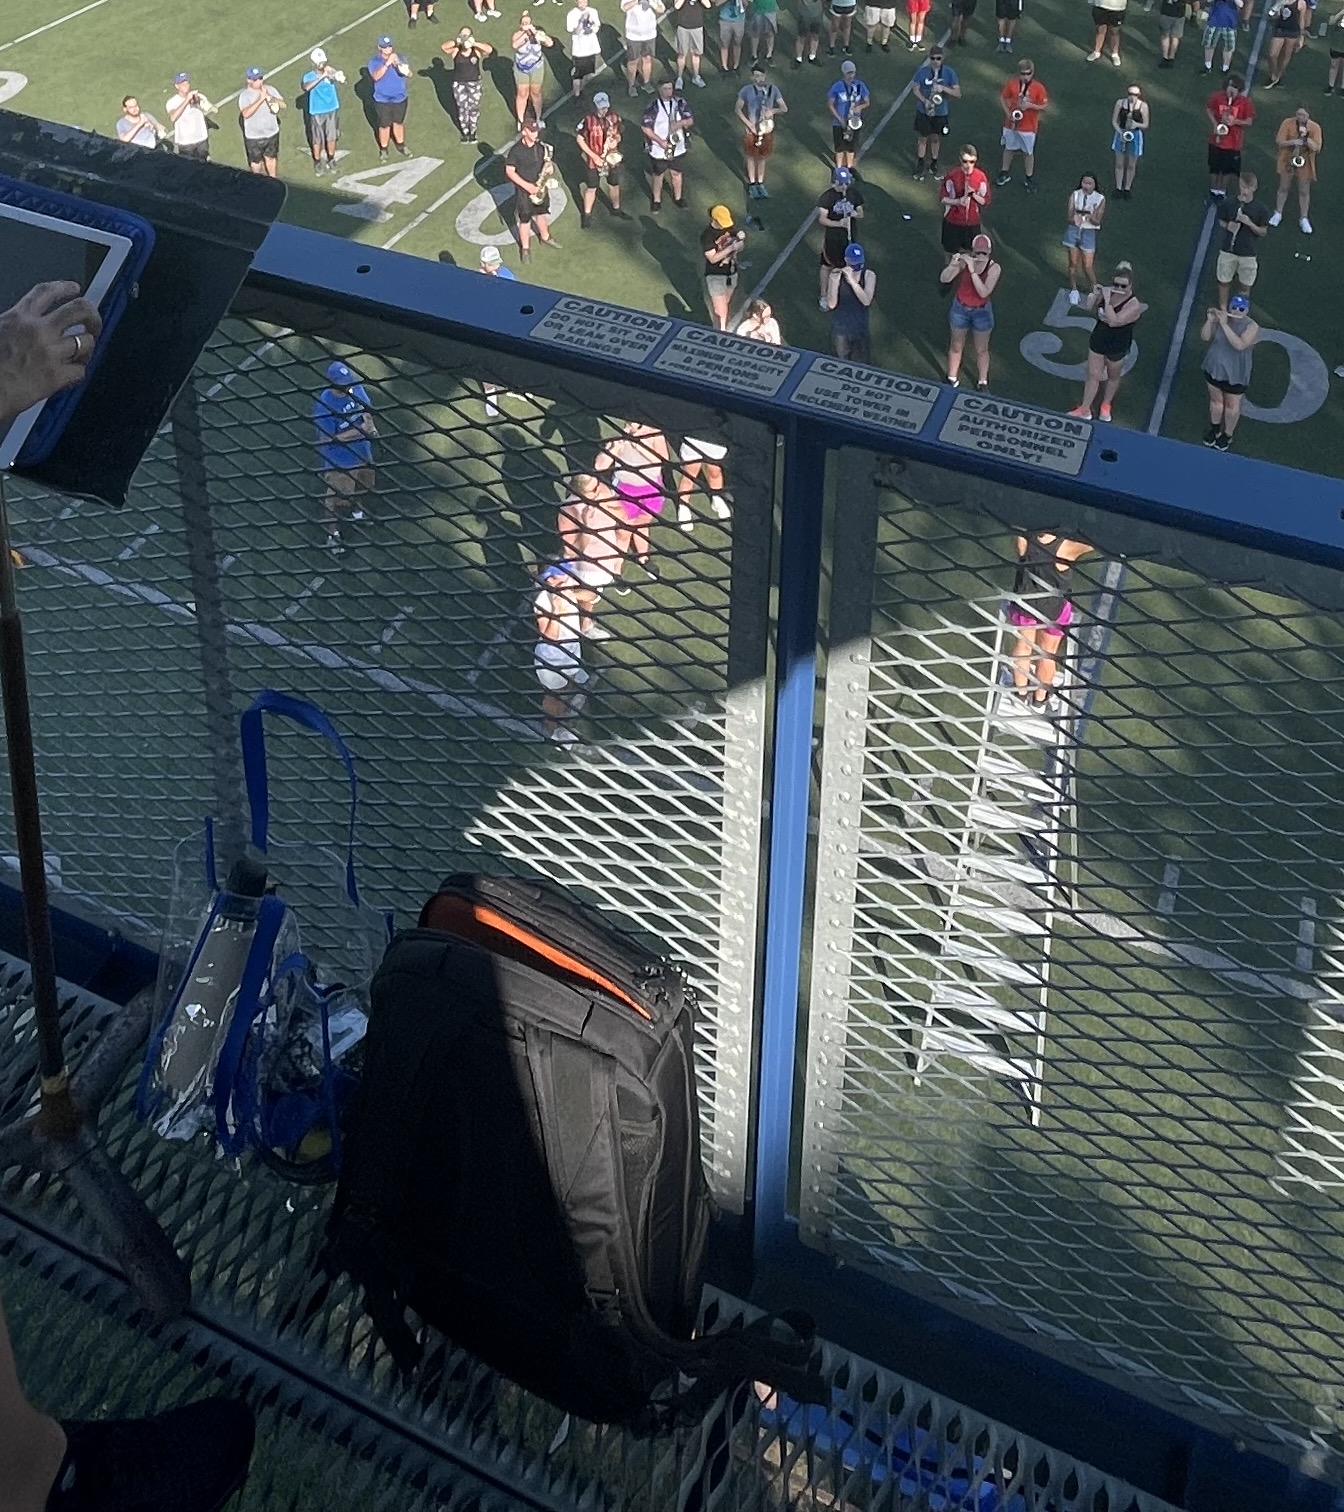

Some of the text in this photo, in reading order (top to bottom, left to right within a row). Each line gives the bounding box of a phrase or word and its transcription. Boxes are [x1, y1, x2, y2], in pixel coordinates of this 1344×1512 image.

[550, 312, 657, 342] DO NOT SIT ON
[564, 300, 665, 330] CAUTION
[543, 320, 564, 330] OR
[609, 337, 649, 351] OVER
[553, 334, 623, 355] RAILINGS
[686, 330, 792, 362] CAUTION
[671, 344, 784, 376] MAXIMUM CAPACITY
[696, 359, 760, 380] PERSONS
[820, 362, 932, 398] CAUTION
[841, 383, 893, 402] DO NOT
[796, 393, 918, 431] INCLEMENT WEATHER
[814, 387, 910, 418] USE TOWER IN
[963, 398, 1083, 436] CAUTION
[957, 425, 1067, 459] PERSONNEL
[959, 414, 1075, 448] AUTHORIZED
[976, 440, 1043, 464] ONLY!
